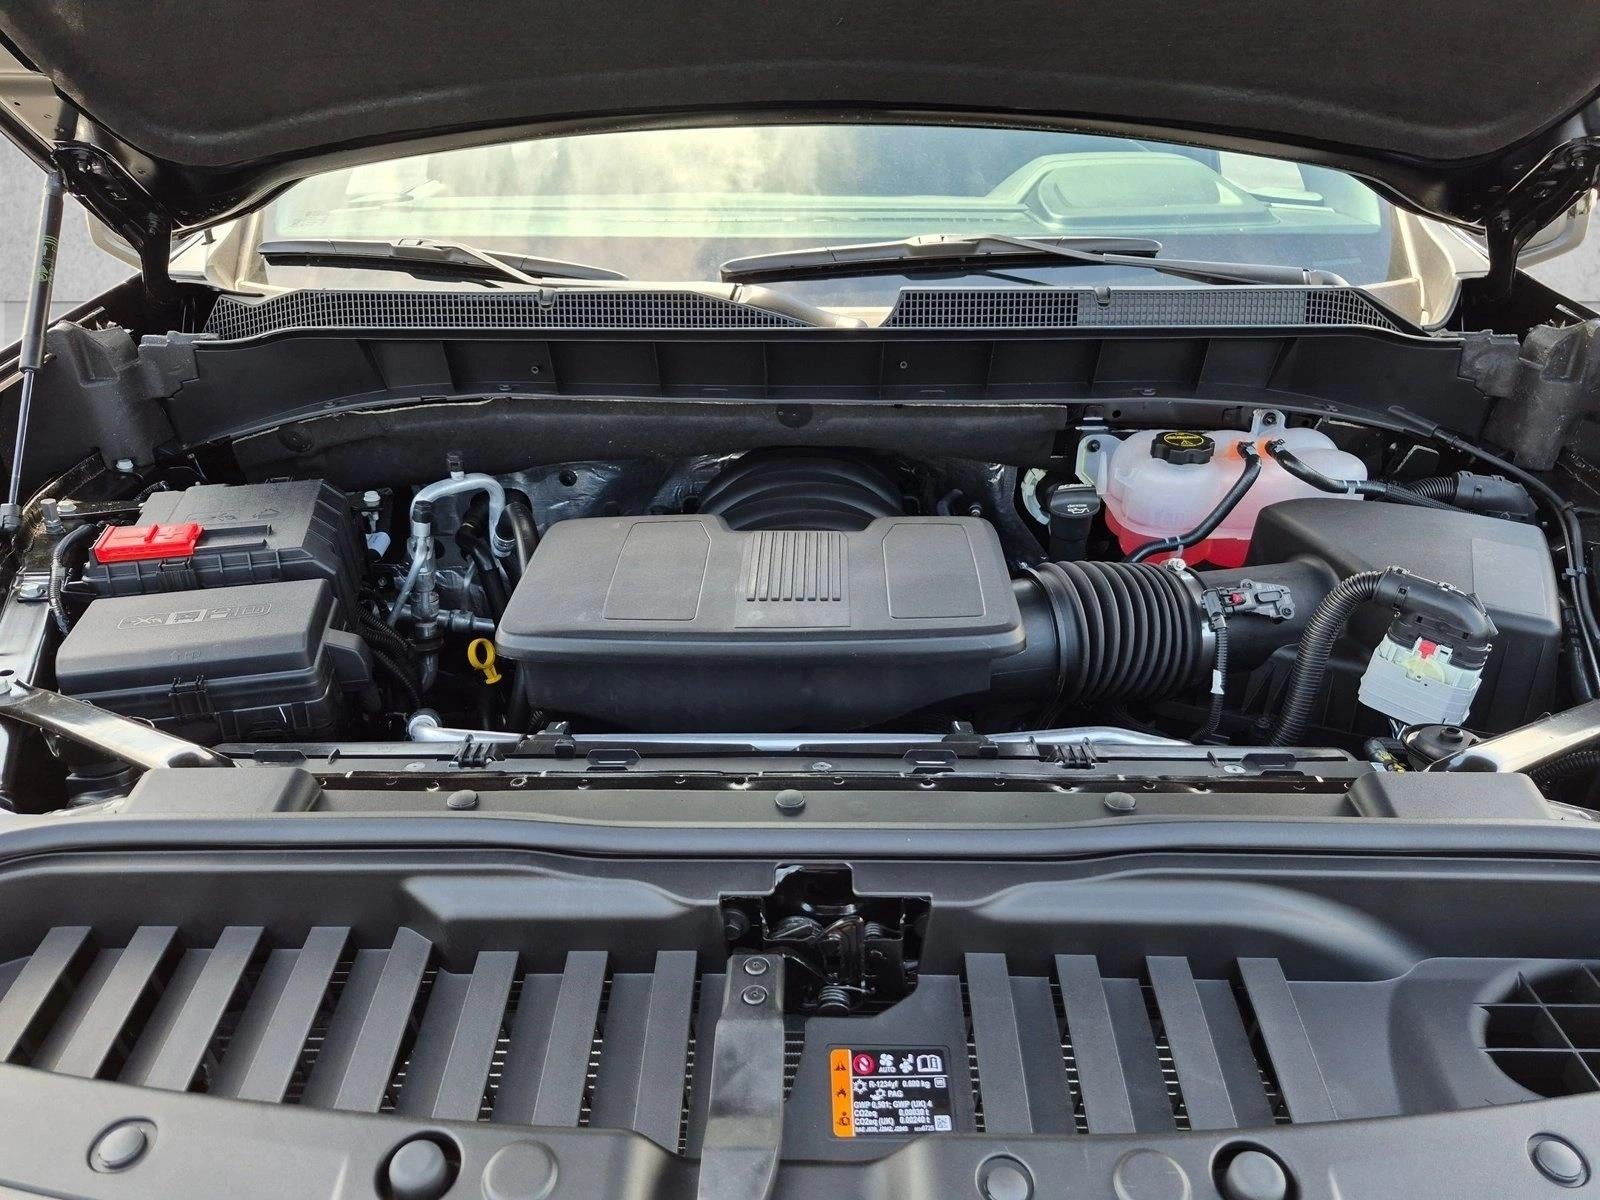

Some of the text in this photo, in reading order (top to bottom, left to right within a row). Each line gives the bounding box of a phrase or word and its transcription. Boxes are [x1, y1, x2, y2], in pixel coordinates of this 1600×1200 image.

[868, 1080, 899, 1089] R-1234yf
[921, 1080, 931, 1089] kg
[911, 1100, 927, 1109] (UK)
[854, 1110, 878, 1118] CO2eq
[854, 1118, 878, 1126] CO2eq
[879, 1118, 895, 1126] (UK)
